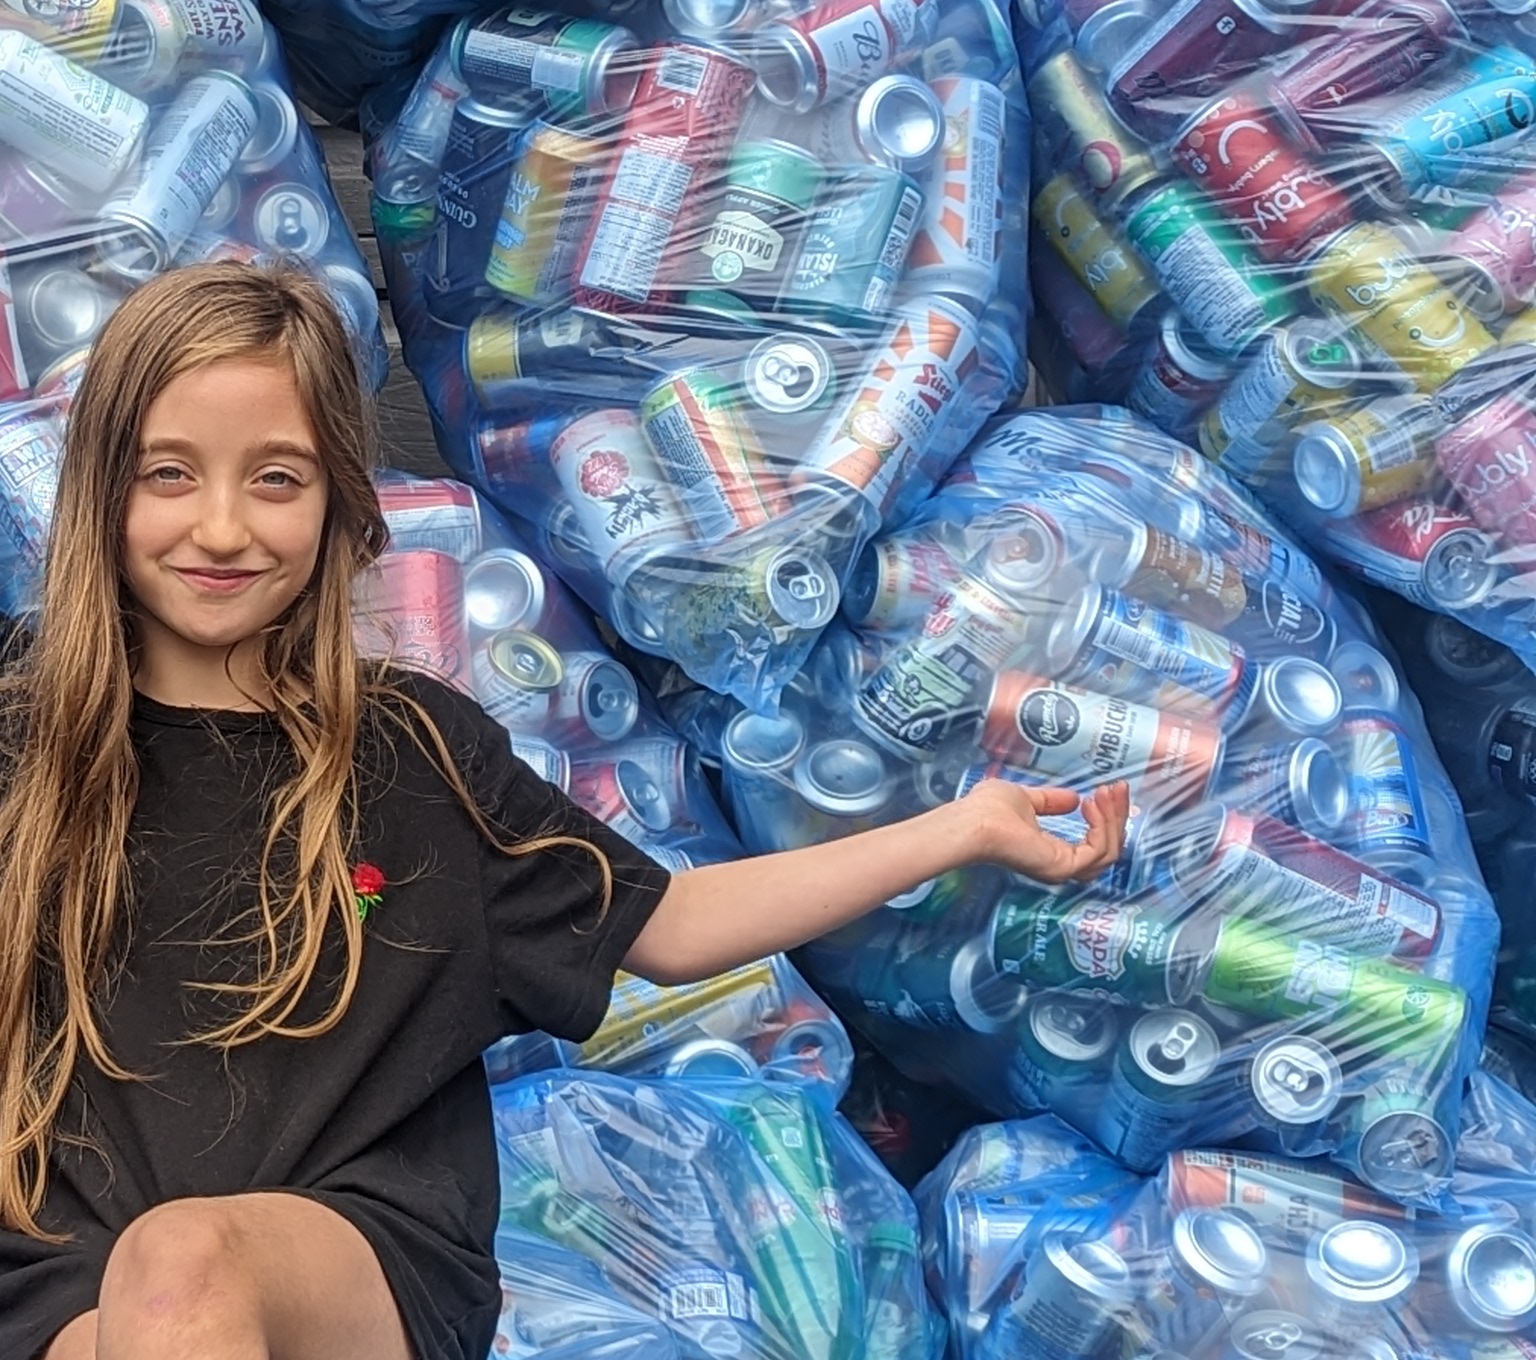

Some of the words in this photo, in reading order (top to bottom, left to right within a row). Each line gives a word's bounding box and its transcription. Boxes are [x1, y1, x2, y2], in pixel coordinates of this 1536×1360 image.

[514, 174, 541, 200] ALM
[433, 198, 479, 230] GUIN
[1084, 245, 1128, 291] bly
[1279, 590, 1304, 626] CIAL
[1039, 690, 1062, 744] Remedy
[1088, 904, 1122, 979] ANADA
